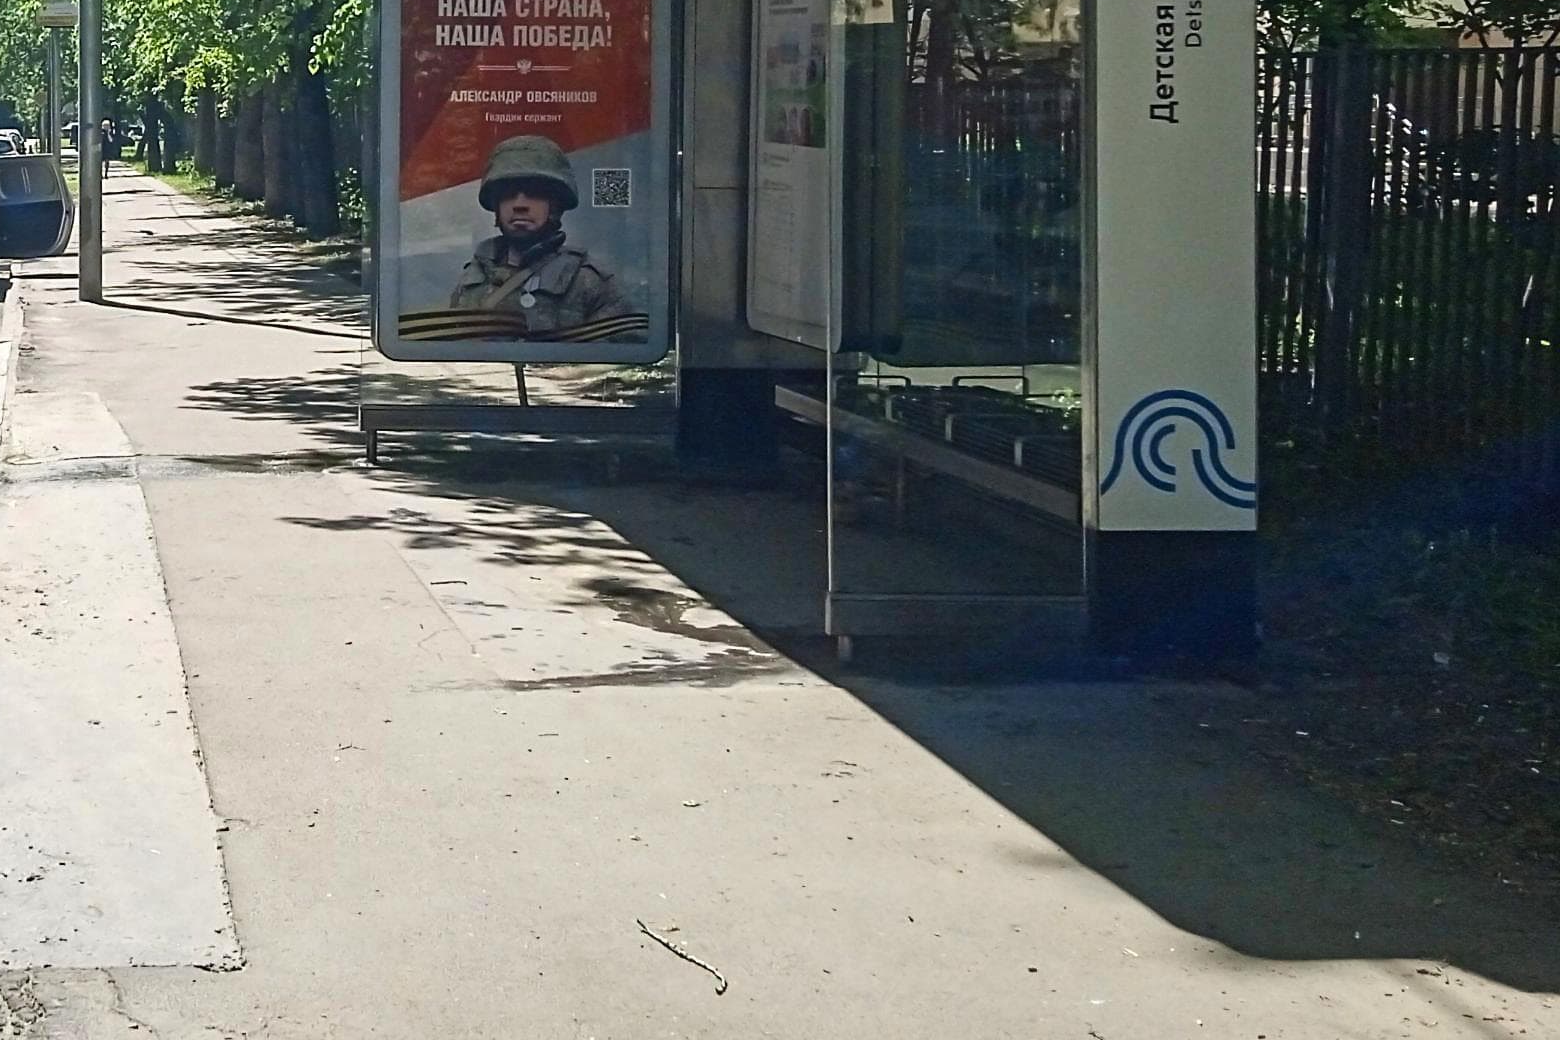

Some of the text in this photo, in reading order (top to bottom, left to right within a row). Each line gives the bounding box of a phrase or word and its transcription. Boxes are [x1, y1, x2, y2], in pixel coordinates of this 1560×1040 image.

[435, 24, 613, 51] НАША ПОБЕДА!
[1149, 5, 1179, 123] Детская
[450, 90, 598, 104] АЛЕКСАНДР ОВСЯНИКОВ
[524, 113, 562, 123] сержант
